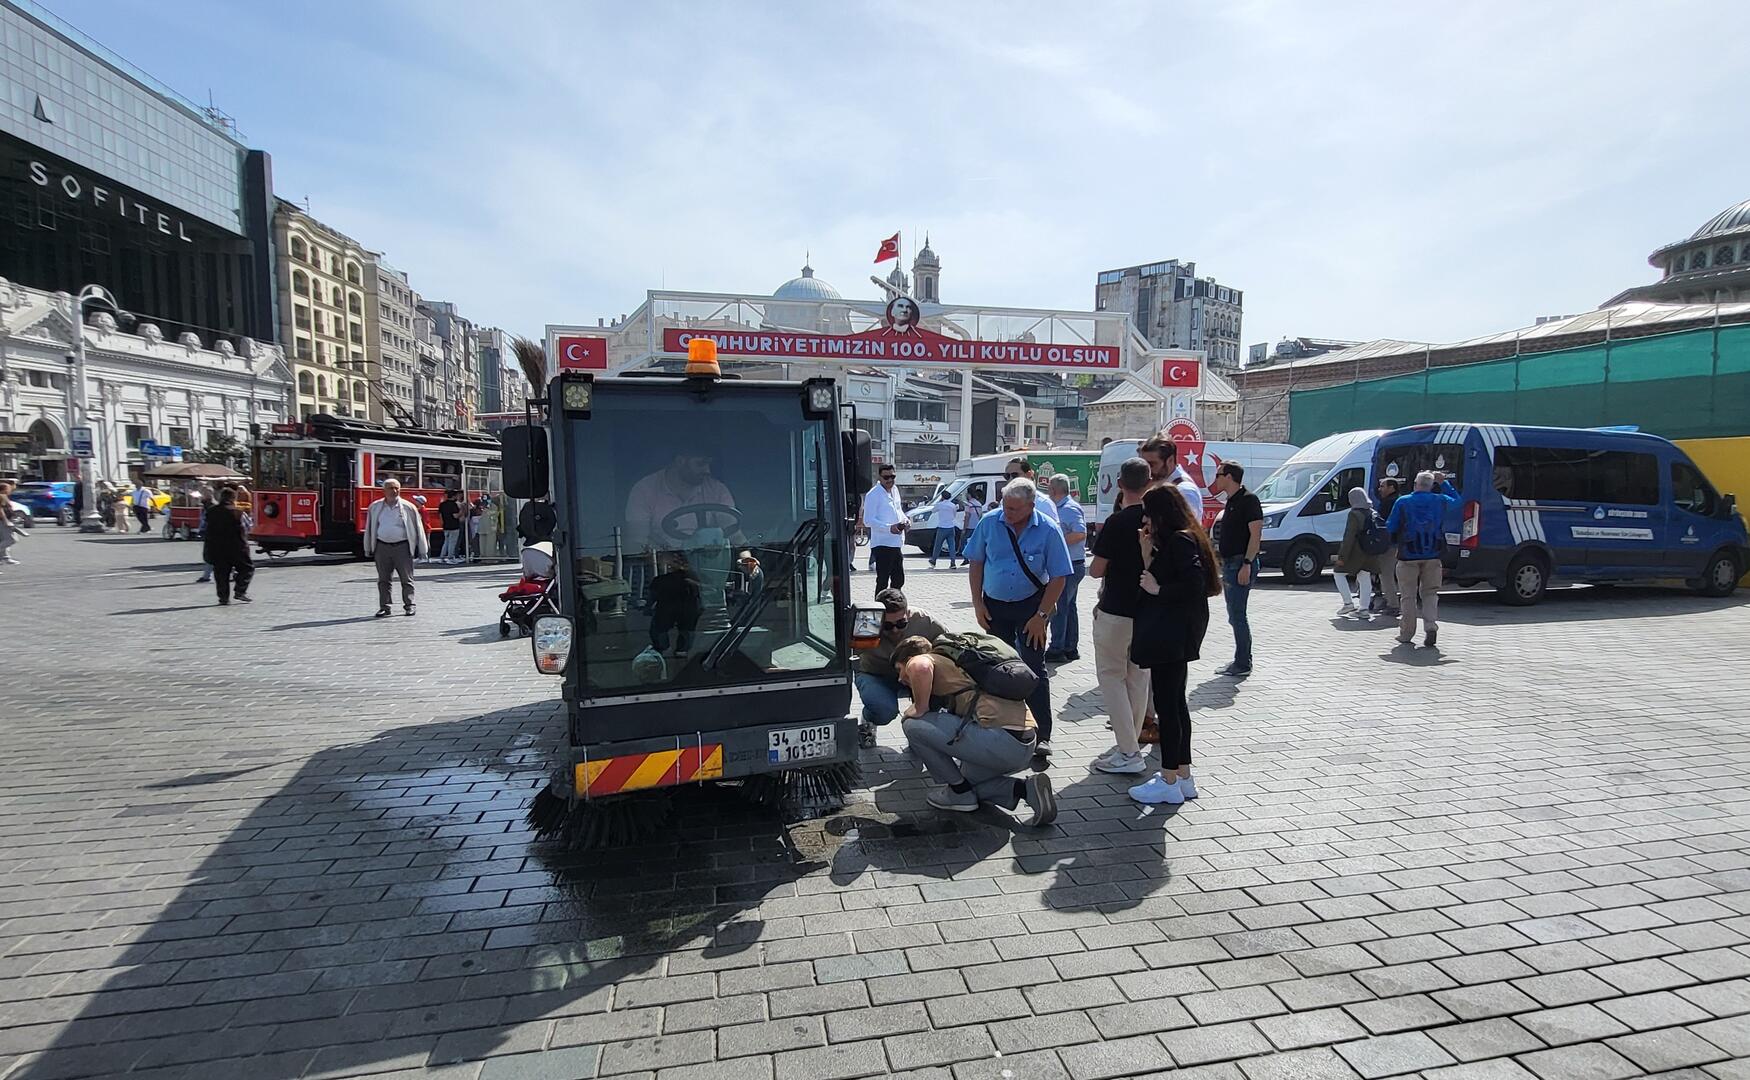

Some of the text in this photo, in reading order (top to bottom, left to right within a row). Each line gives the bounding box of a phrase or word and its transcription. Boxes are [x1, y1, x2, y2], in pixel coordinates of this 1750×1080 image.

[29, 160, 193, 243] SOFITEL
[678, 333, 1110, 364] CMHURİYETİMİZİN 100. YILI KUTLU OLSUN
[772, 726, 830, 747] 34 0019
